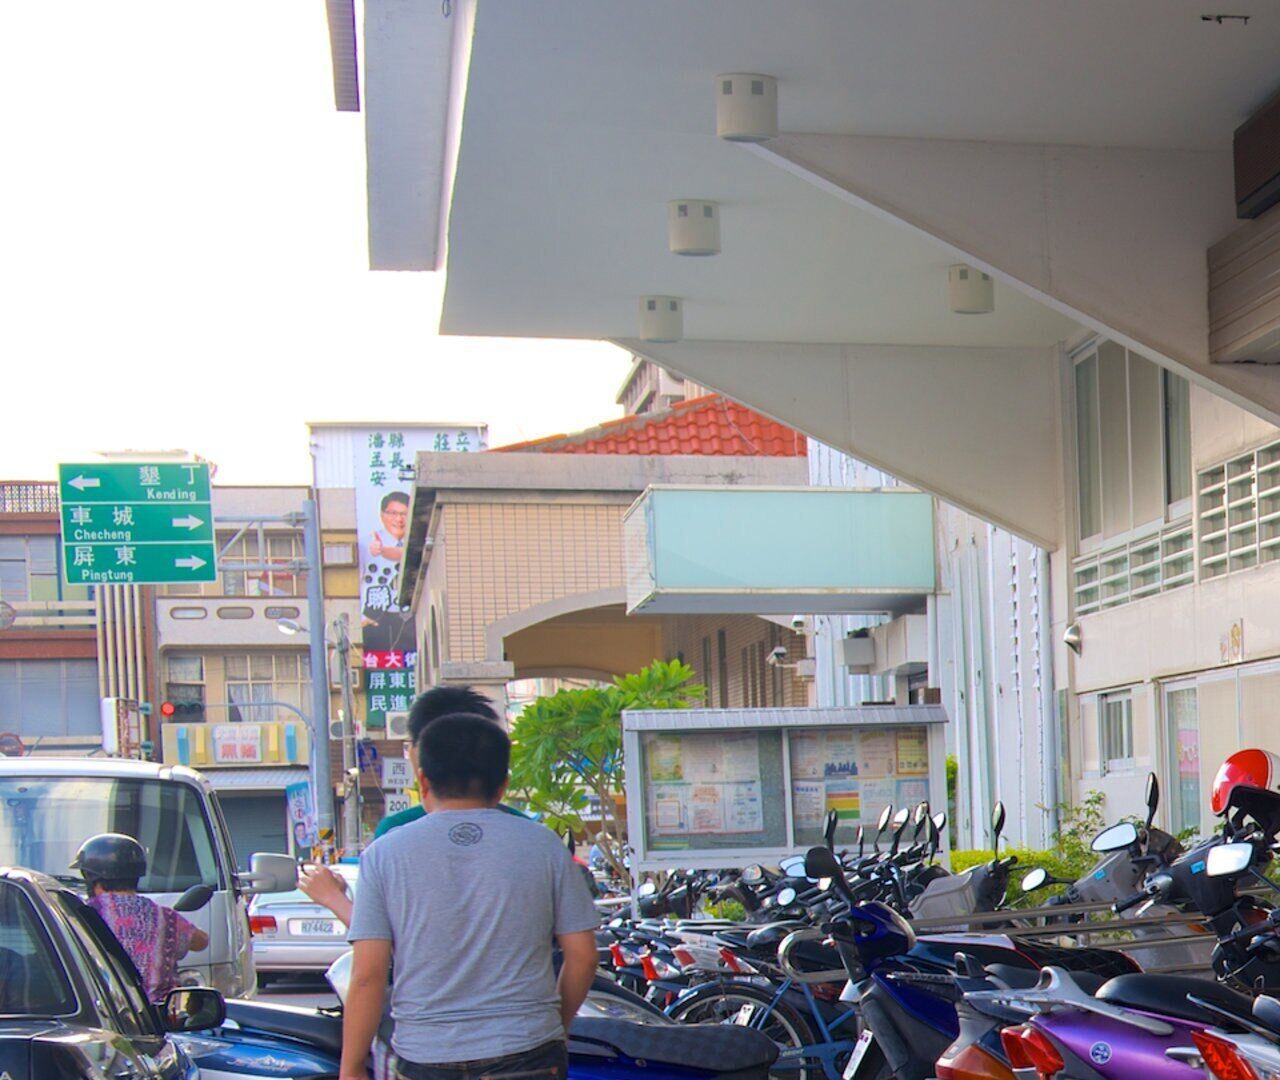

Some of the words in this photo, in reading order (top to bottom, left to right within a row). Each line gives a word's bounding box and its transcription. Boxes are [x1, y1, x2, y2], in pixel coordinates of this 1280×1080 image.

[139, 464, 201, 486] 墾丁
[147, 488, 197, 501] Kending
[70, 506, 135, 526] 車城
[74, 529, 132, 541] Checheng
[73, 546, 136, 566] 屏東
[82, 570, 134, 582] Pingtung
[392, 762, 406, 775] 西
[389, 800, 408, 812] 200
